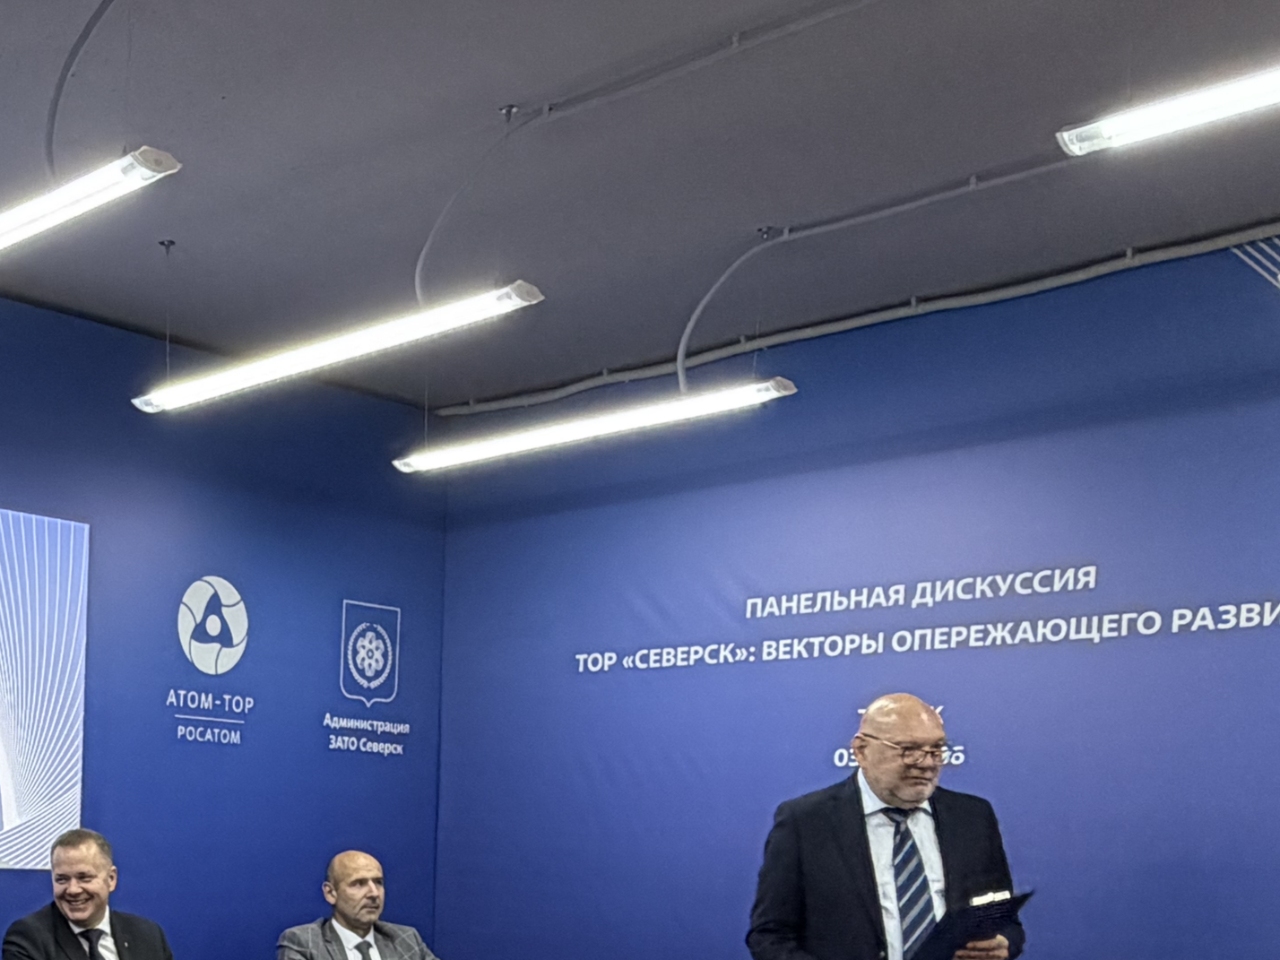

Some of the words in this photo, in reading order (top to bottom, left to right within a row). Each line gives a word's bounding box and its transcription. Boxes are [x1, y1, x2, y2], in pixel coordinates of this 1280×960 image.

[745, 584, 905, 619] ПАНЕЛЬНАЯ
[912, 566, 1097, 608] ДИСКУССИЯ
[575, 652, 617, 673] ТОР
[622, 643, 756, 670] «СЕВЕРСК»:
[761, 632, 884, 662] ВЕКТОРЫ
[891, 611, 1163, 652] ОПЕРЕЖАЮЩЕГО
[166, 689, 255, 714] АТОМ-ТОР
[177, 725, 241, 744] РОСАТОМ
[323, 713, 410, 734] Администрация
[329, 735, 357, 751] ЗАТО
[359, 738, 404, 756] Северск
